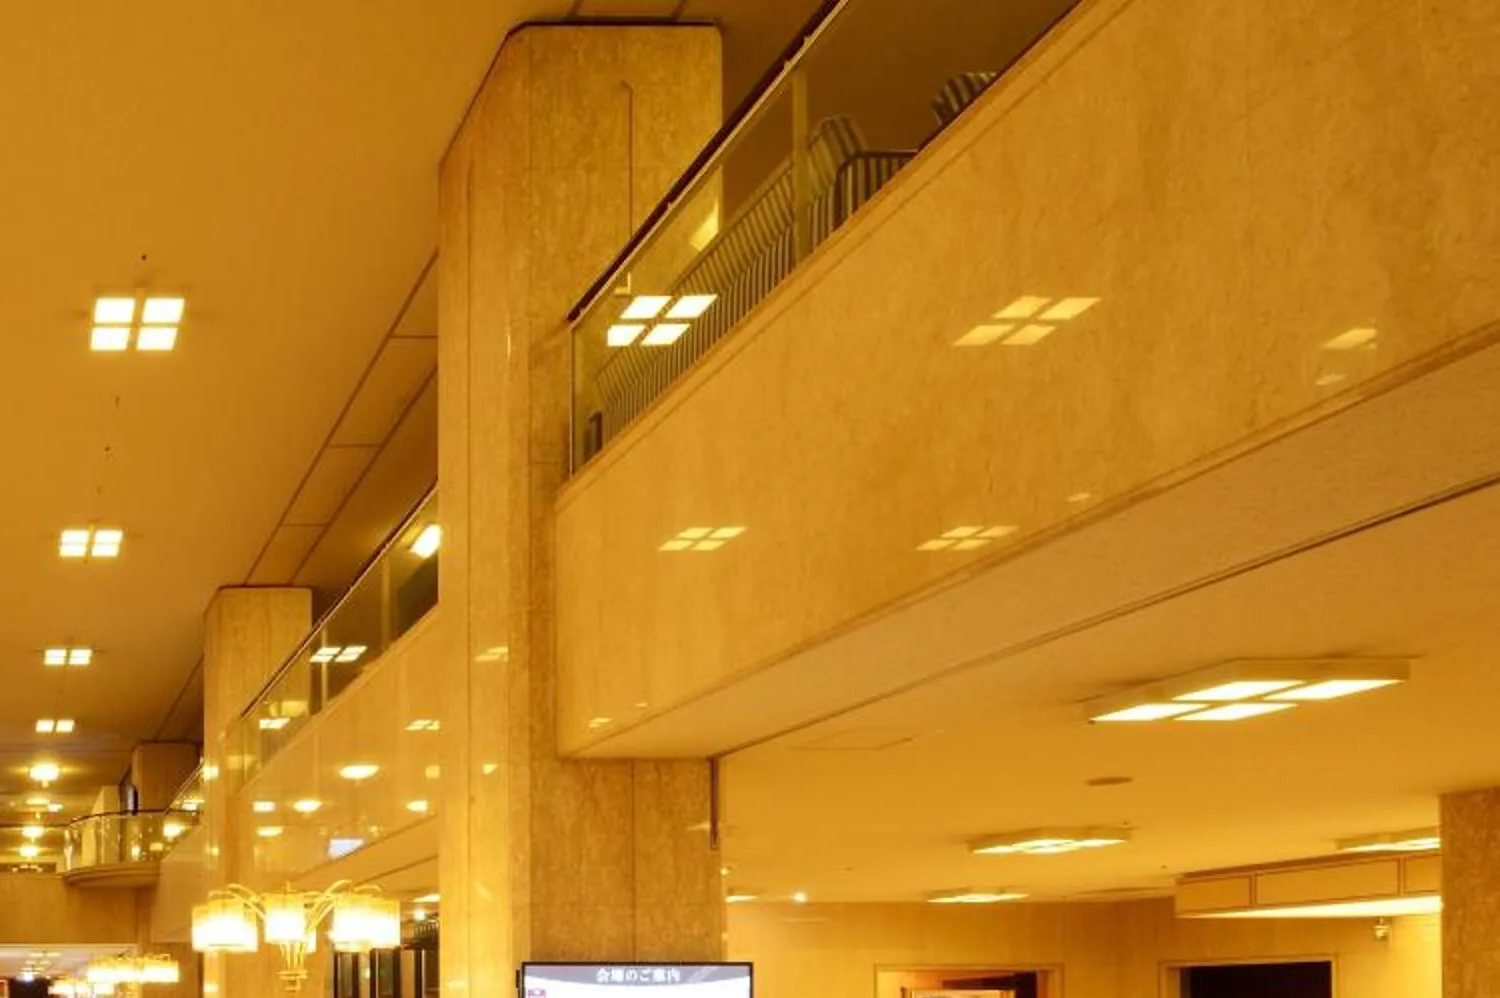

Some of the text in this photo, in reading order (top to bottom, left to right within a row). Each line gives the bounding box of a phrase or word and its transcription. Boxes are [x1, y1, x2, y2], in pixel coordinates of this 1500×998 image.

[596, 968, 681, 982] 会場のご案内
